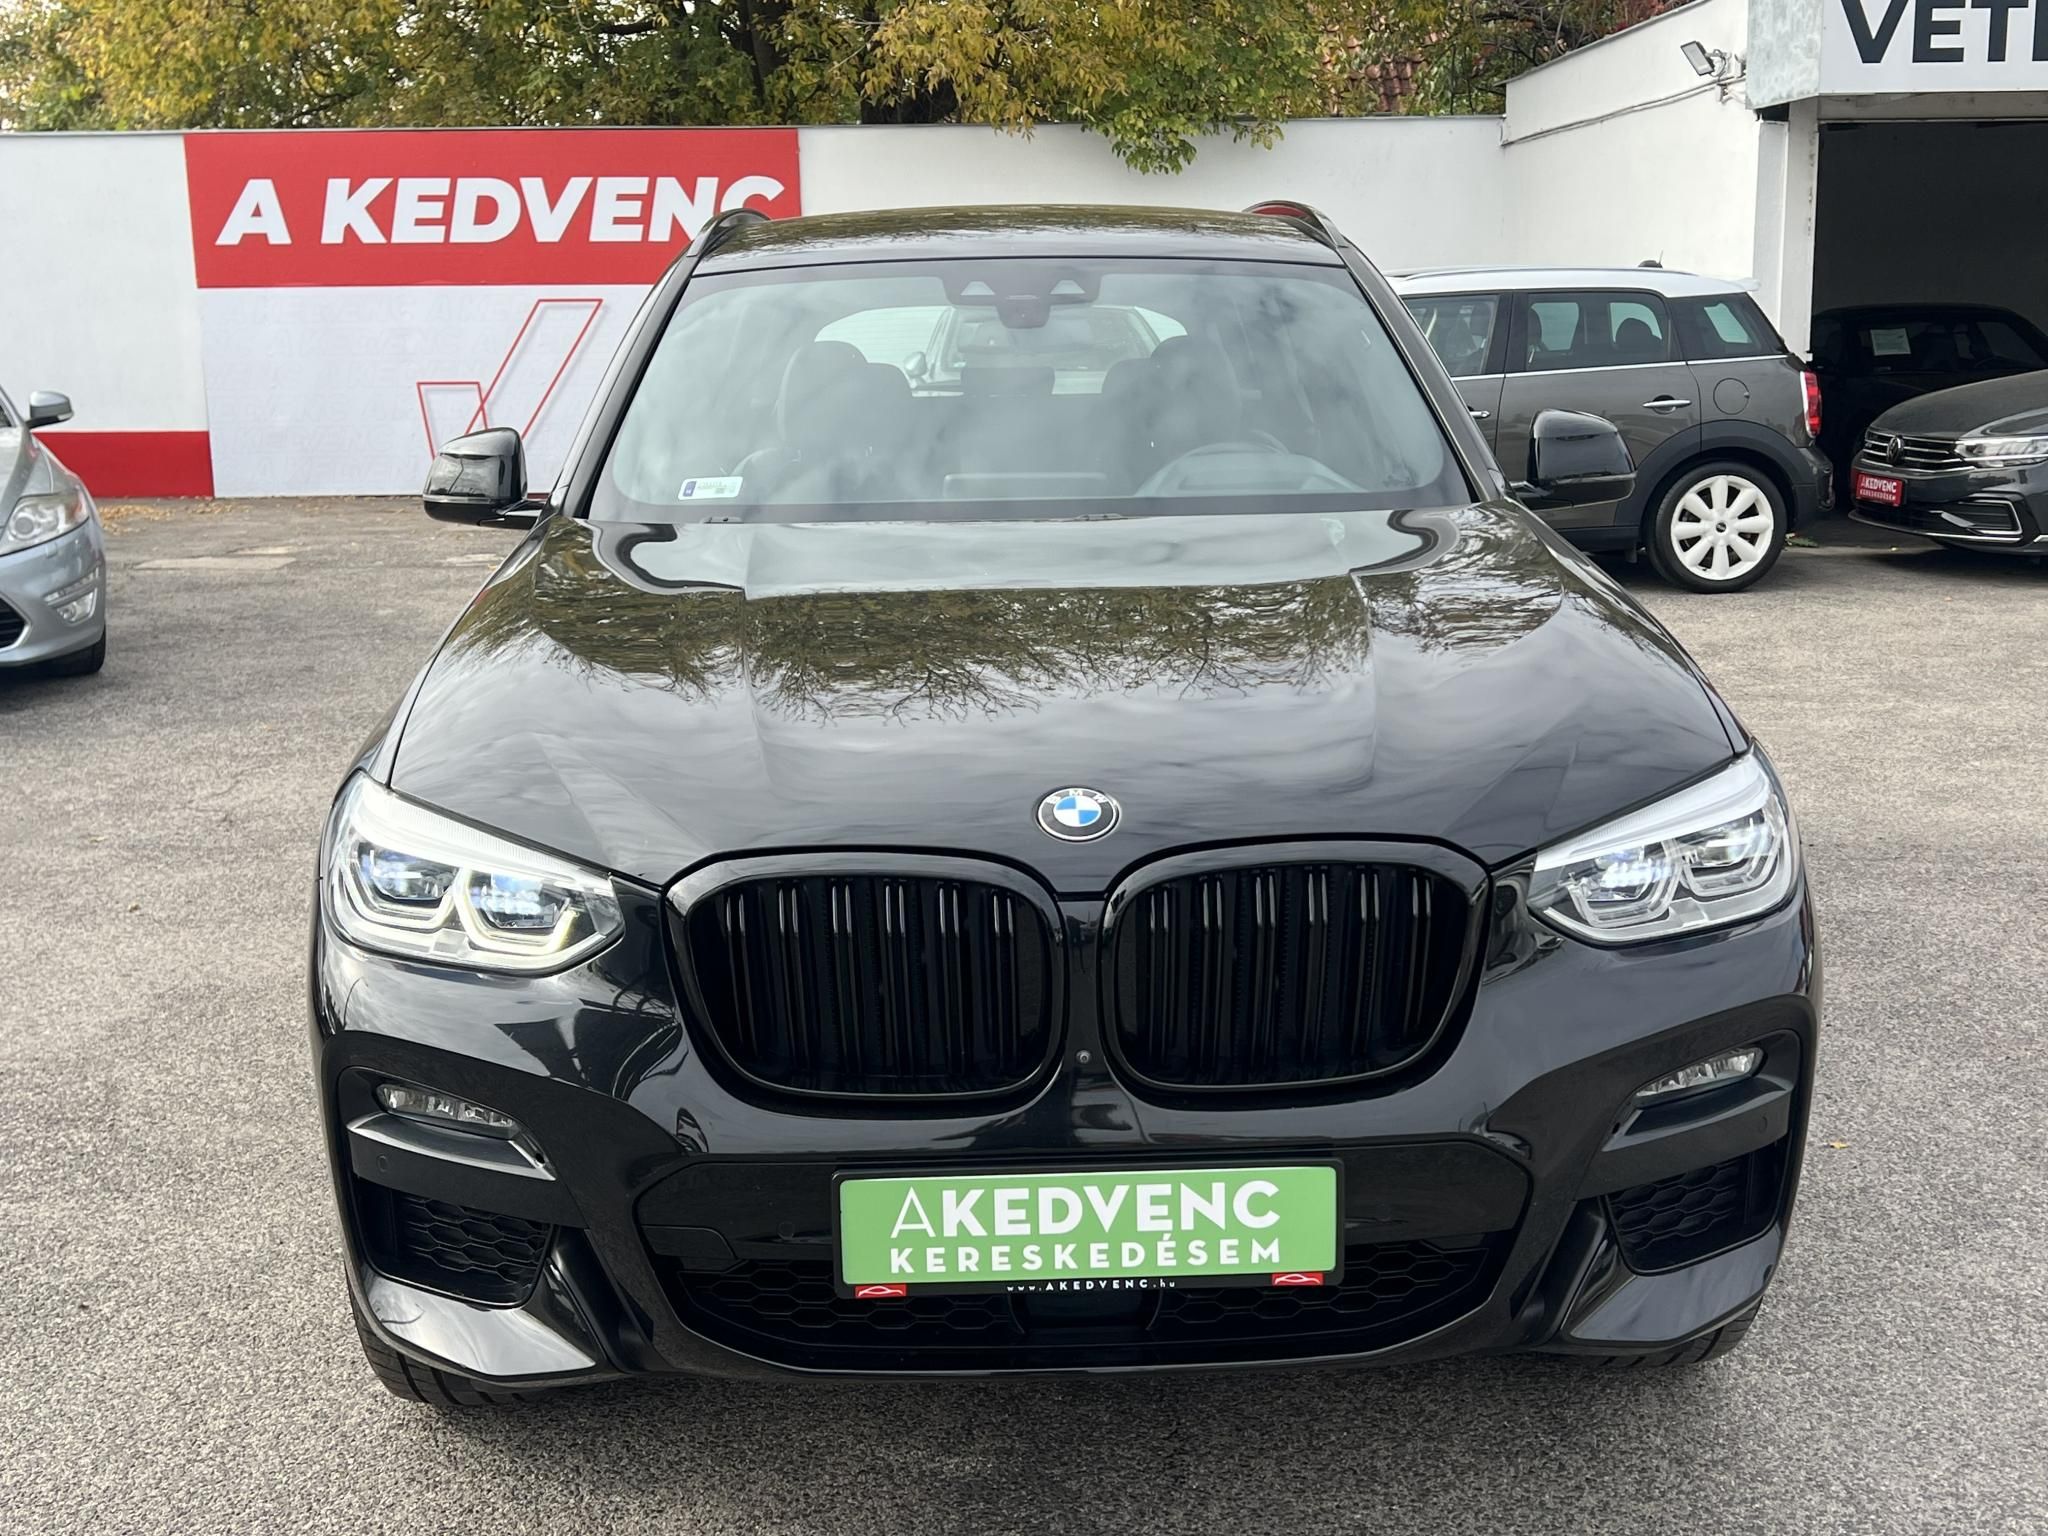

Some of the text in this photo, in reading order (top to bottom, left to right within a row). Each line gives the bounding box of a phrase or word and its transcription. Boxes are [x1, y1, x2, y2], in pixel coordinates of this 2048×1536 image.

[1840, 0, 2048, 63] VET
[215, 175, 785, 246] A KEDVENC
[890, 1233, 1280, 1274] KERESKEDÉSEM
[1007, 1279, 1176, 1292] www.AKEDVENC.hu
